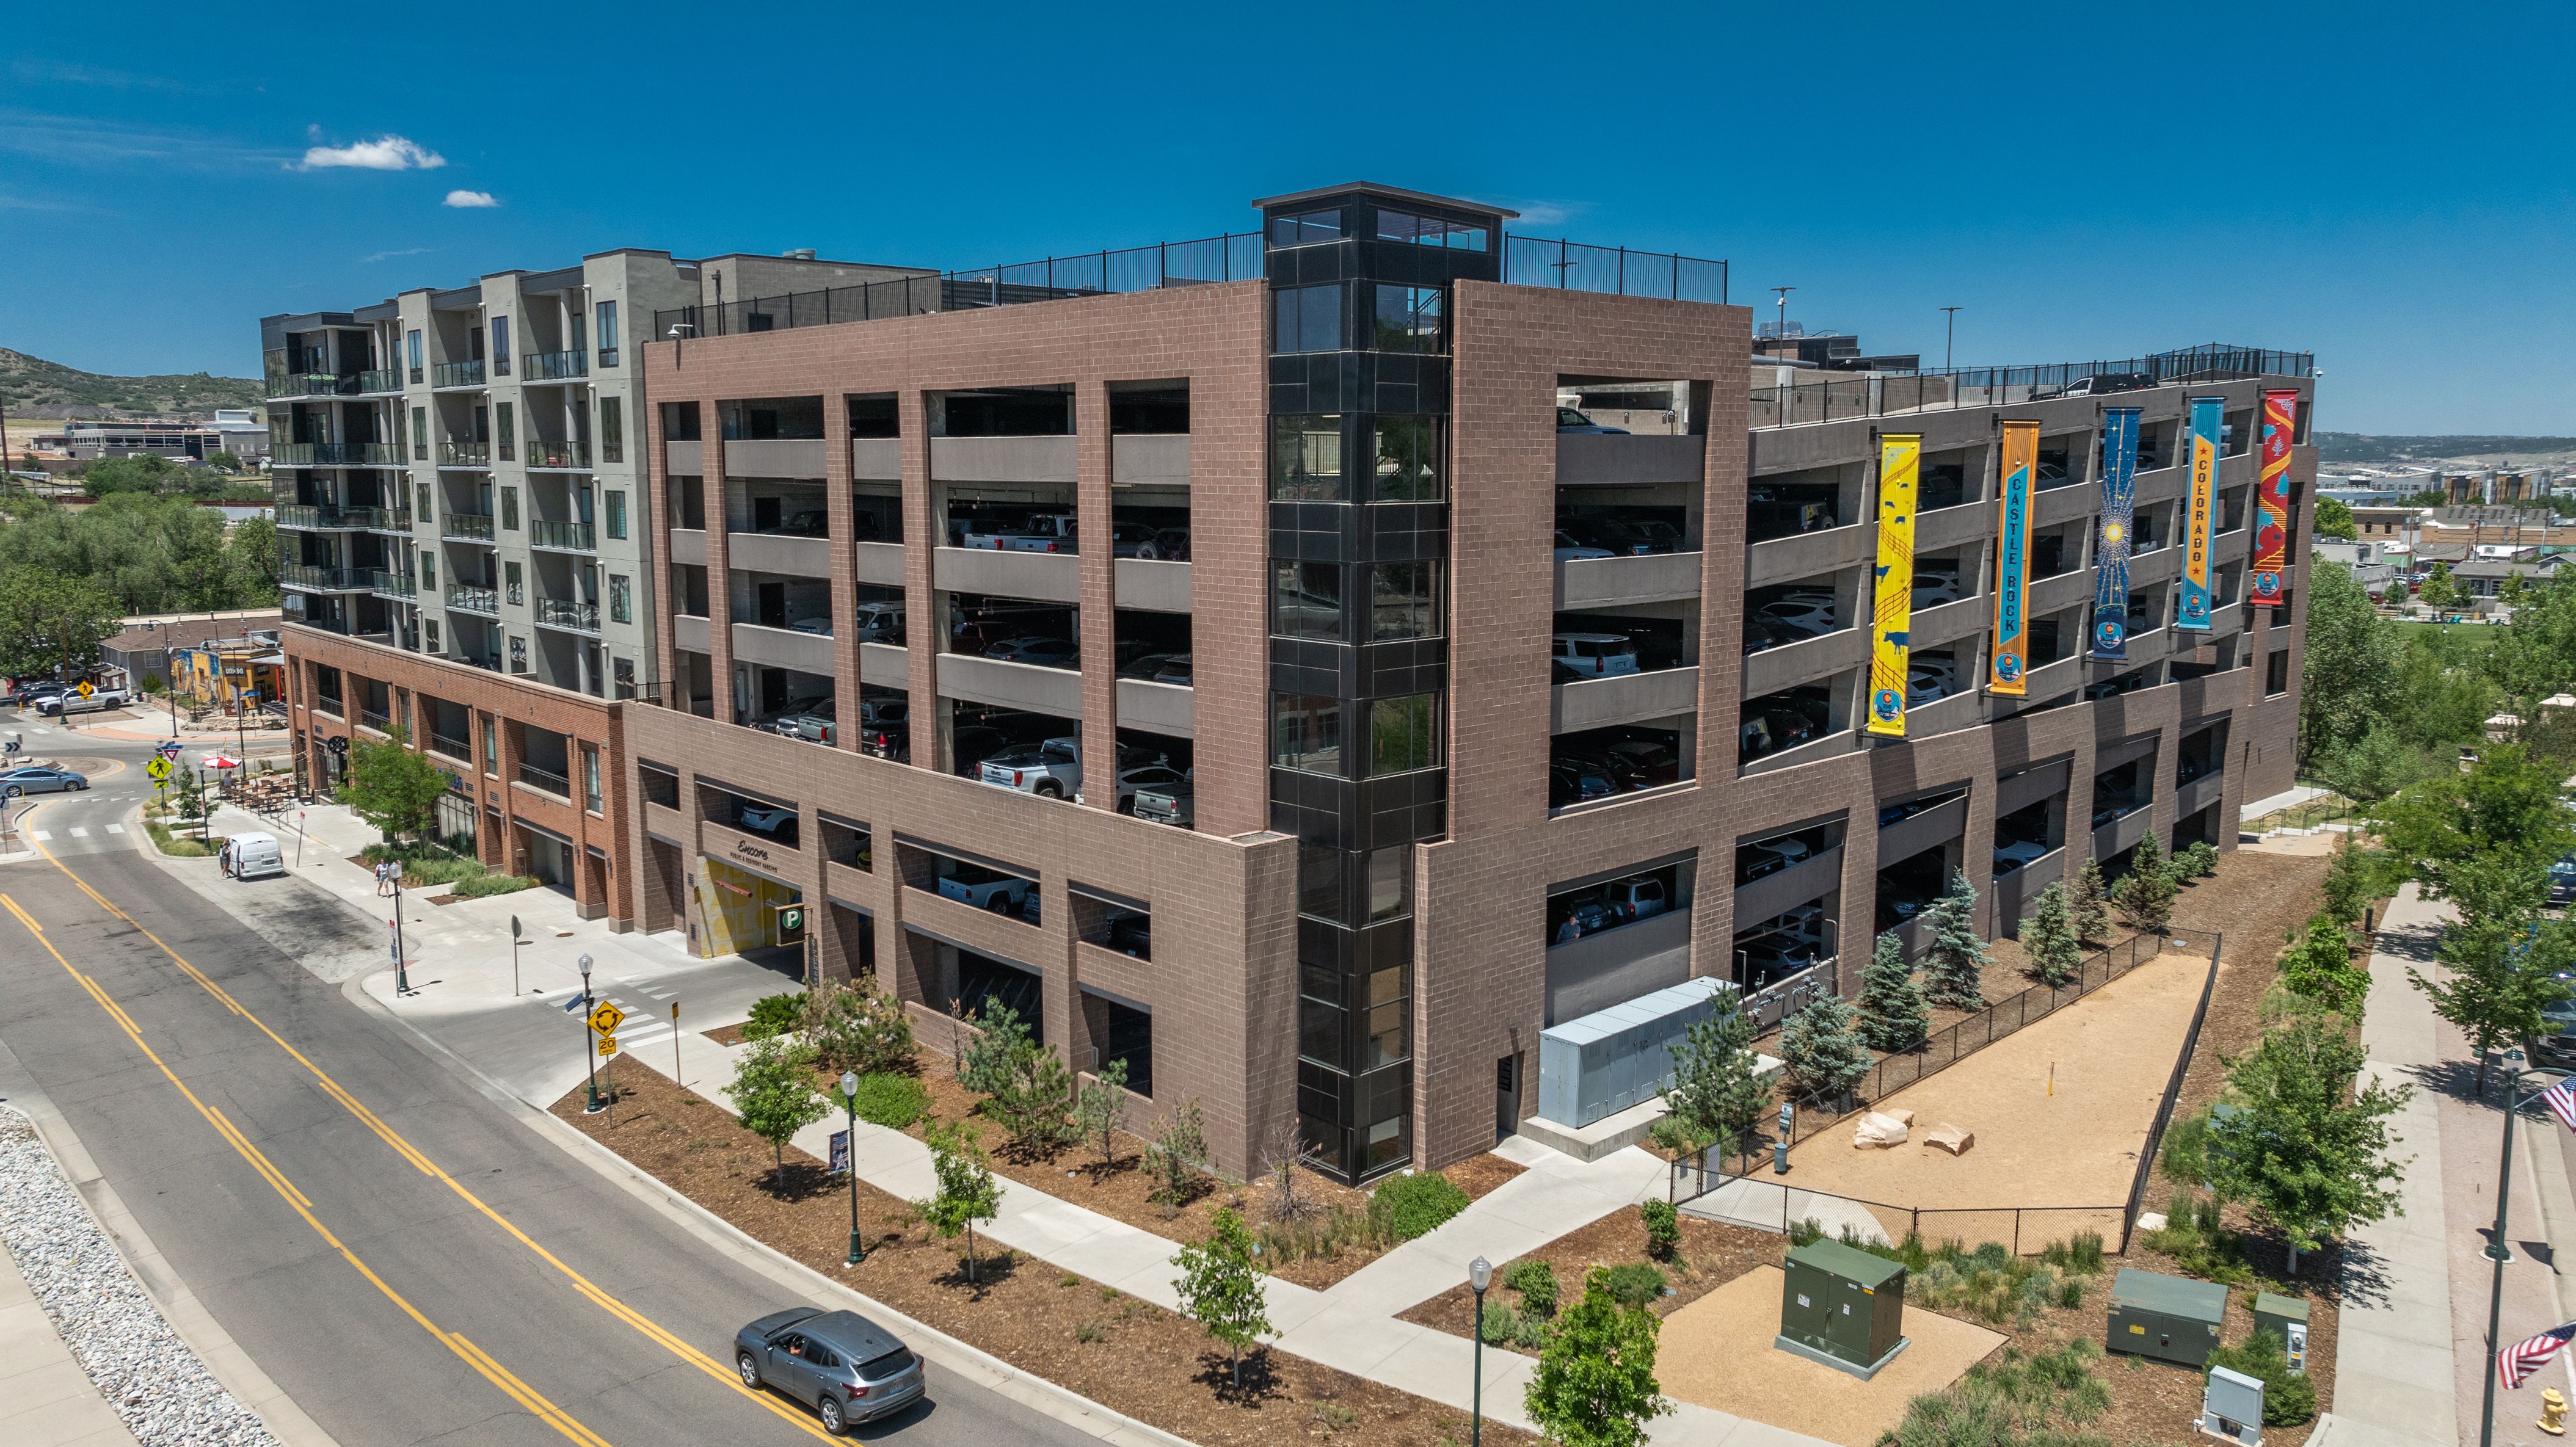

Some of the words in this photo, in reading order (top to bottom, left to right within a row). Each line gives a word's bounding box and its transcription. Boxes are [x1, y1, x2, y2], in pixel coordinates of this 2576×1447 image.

[2009, 479, 2021, 564] CASTLE
[2193, 460, 2207, 562] COLORADO
[2005, 575, 2017, 631] ROCK
[738, 840, 769, 861] Encore
[730, 852, 741, 861] PUBLIC
[746, 857, 762, 867] RESIDENT
[762, 863, 777, 873] PARKING
[787, 911, 799, 927] P
[600, 1040, 614, 1049] 20
